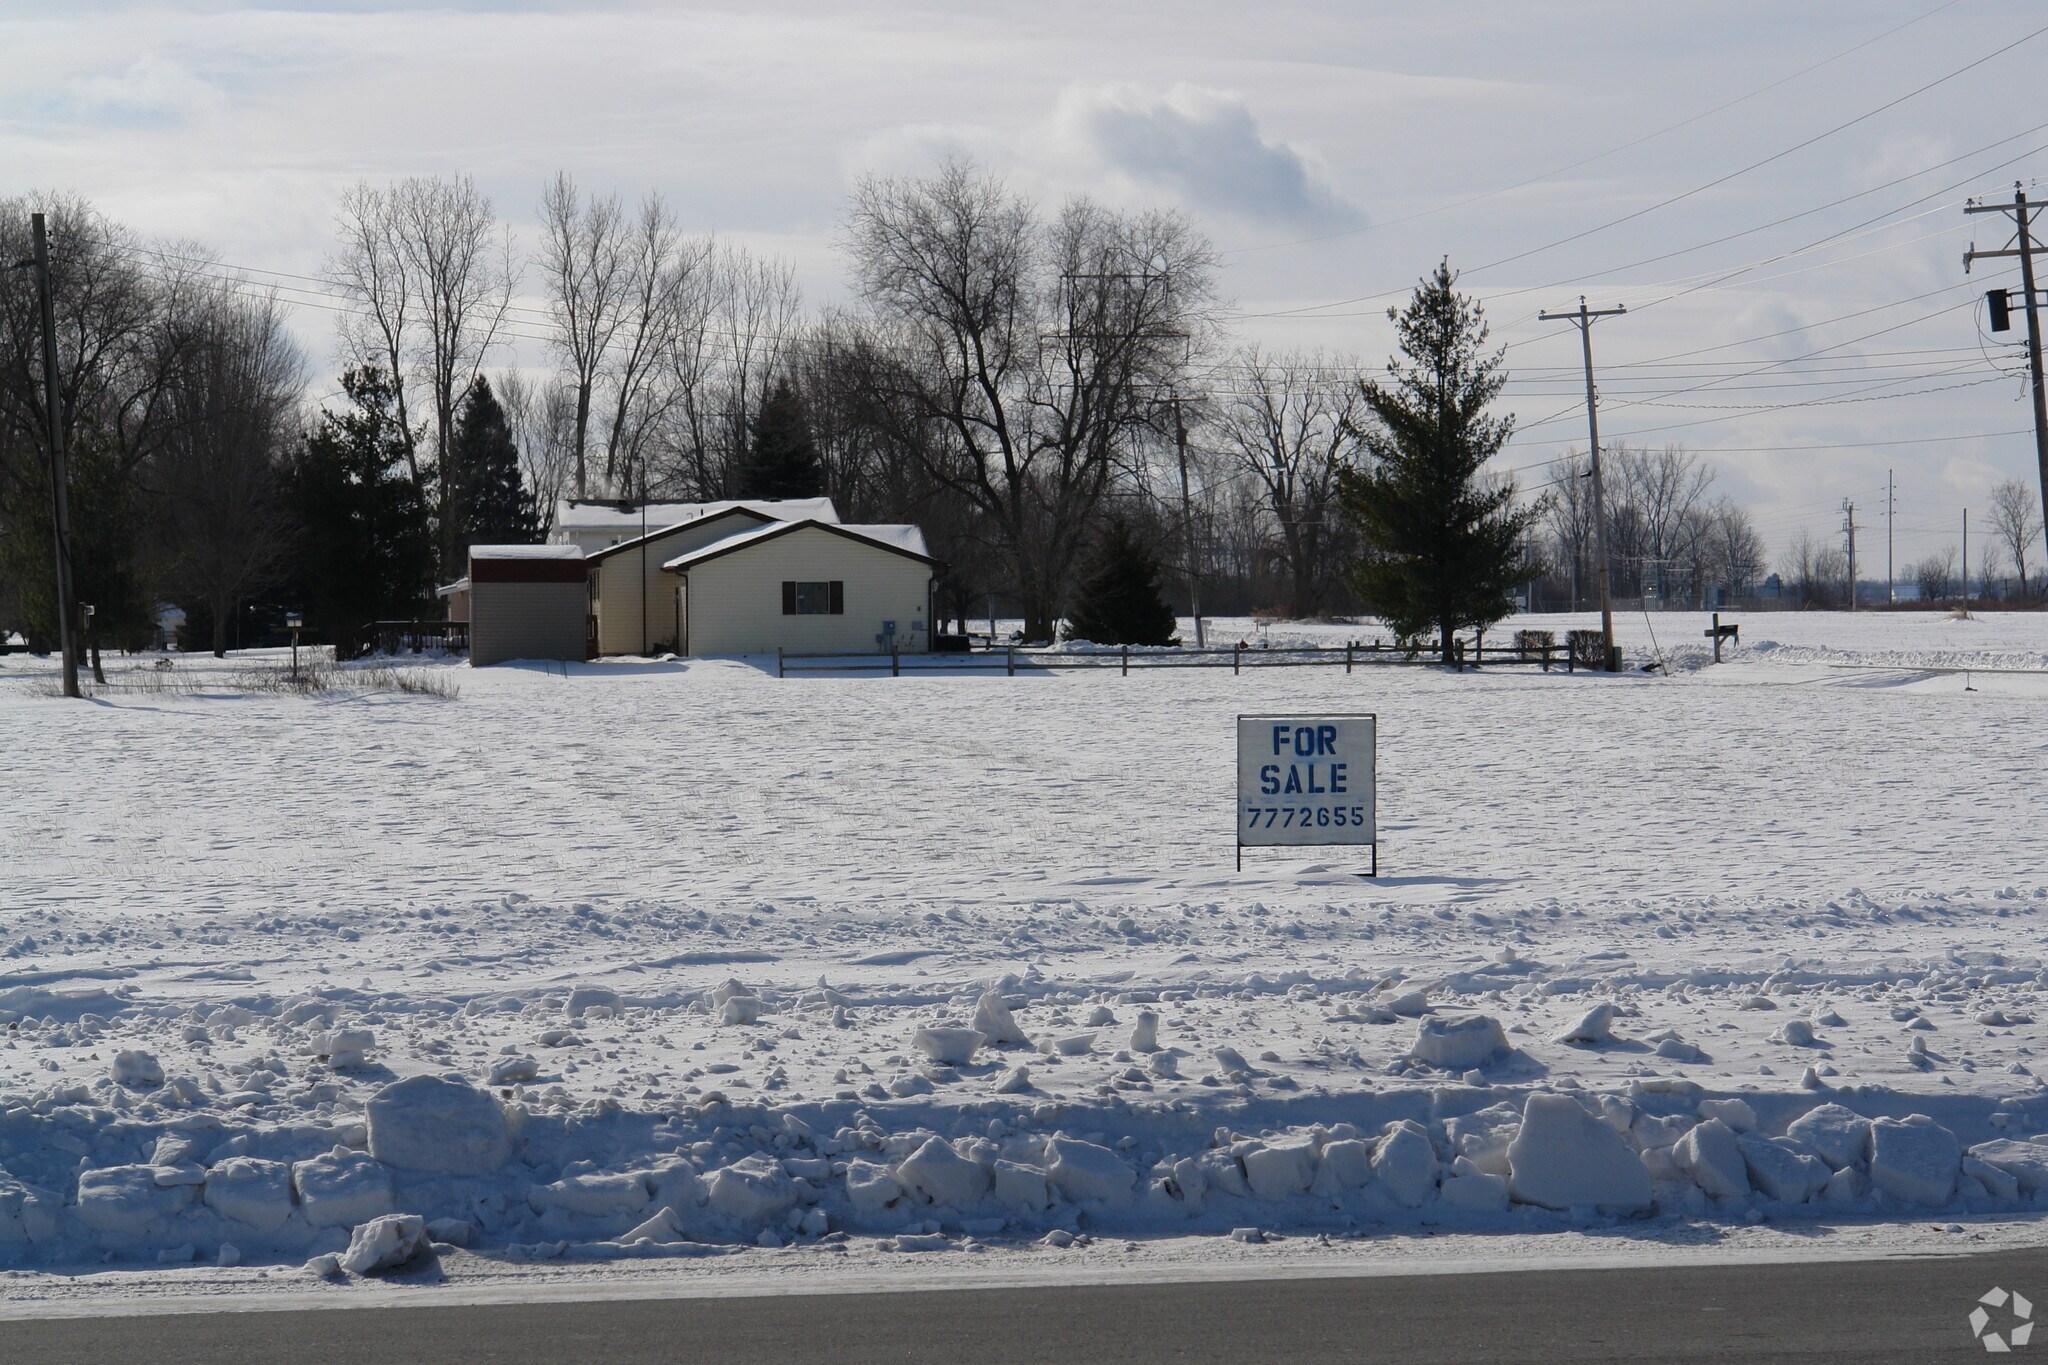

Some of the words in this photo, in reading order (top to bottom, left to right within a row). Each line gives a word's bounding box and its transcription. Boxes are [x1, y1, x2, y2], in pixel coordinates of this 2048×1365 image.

[1273, 725, 1337, 756] FOR
[1260, 763, 1347, 795] SALE
[1247, 806, 1364, 828] 7772655
